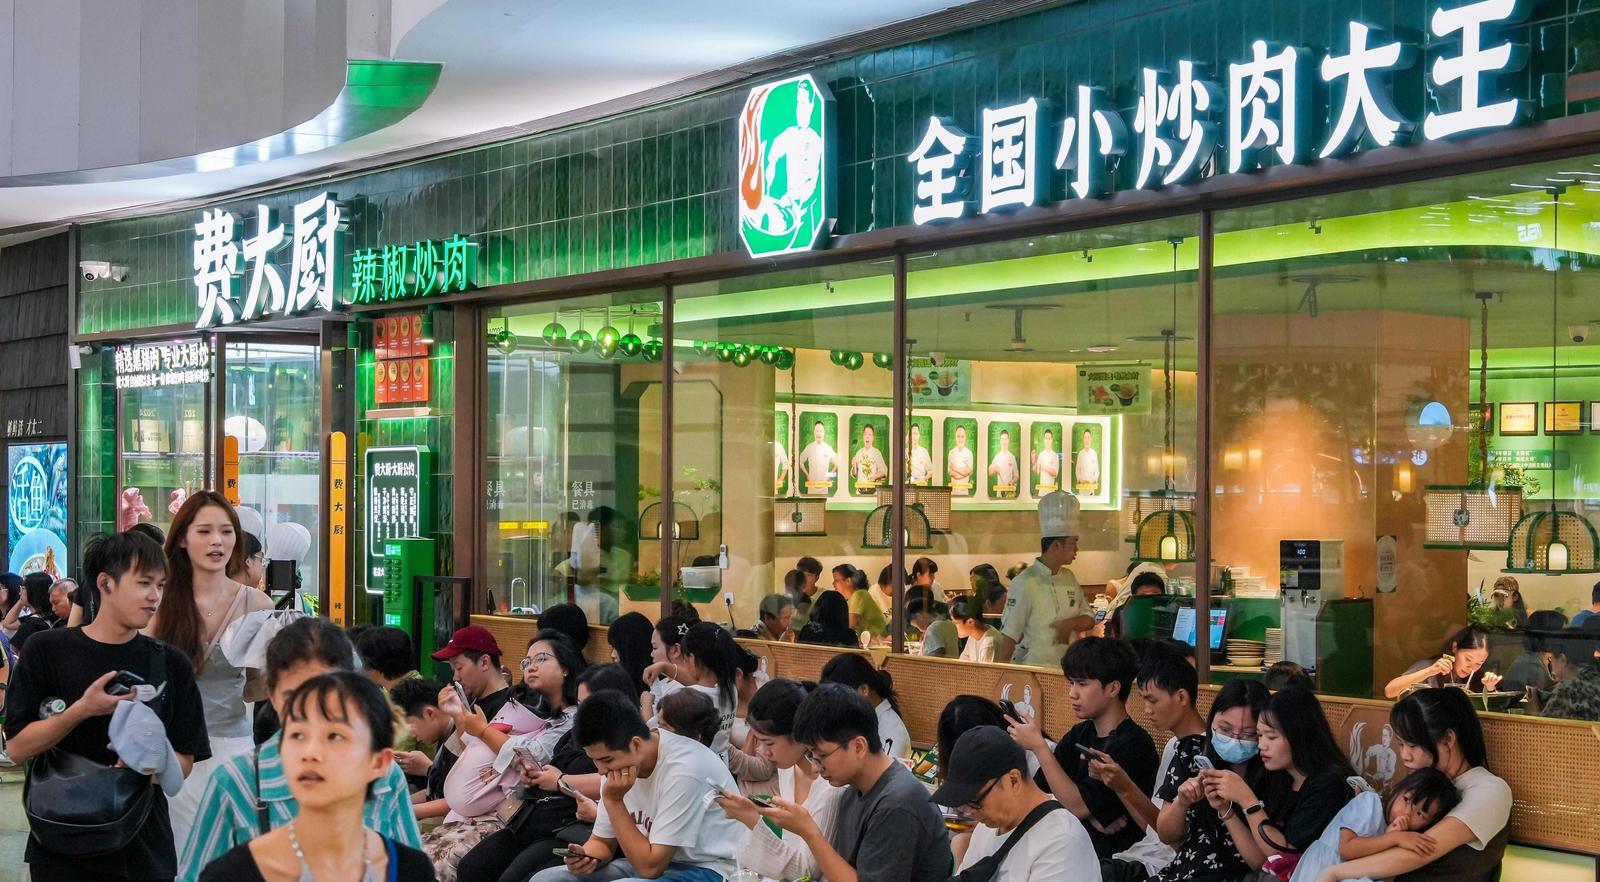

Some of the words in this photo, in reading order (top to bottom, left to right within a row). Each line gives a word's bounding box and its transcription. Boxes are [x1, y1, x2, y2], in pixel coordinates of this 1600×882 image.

[908, 0, 1519, 226] 全国小炒肉大王
[193, 191, 340, 328] 费大厨
[352, 234, 468, 304] 辣椒炒肉
[12, 463, 45, 525] 活鱼
[334, 479, 343, 534] 费大厨
[571, 480, 595, 498] 餐具
